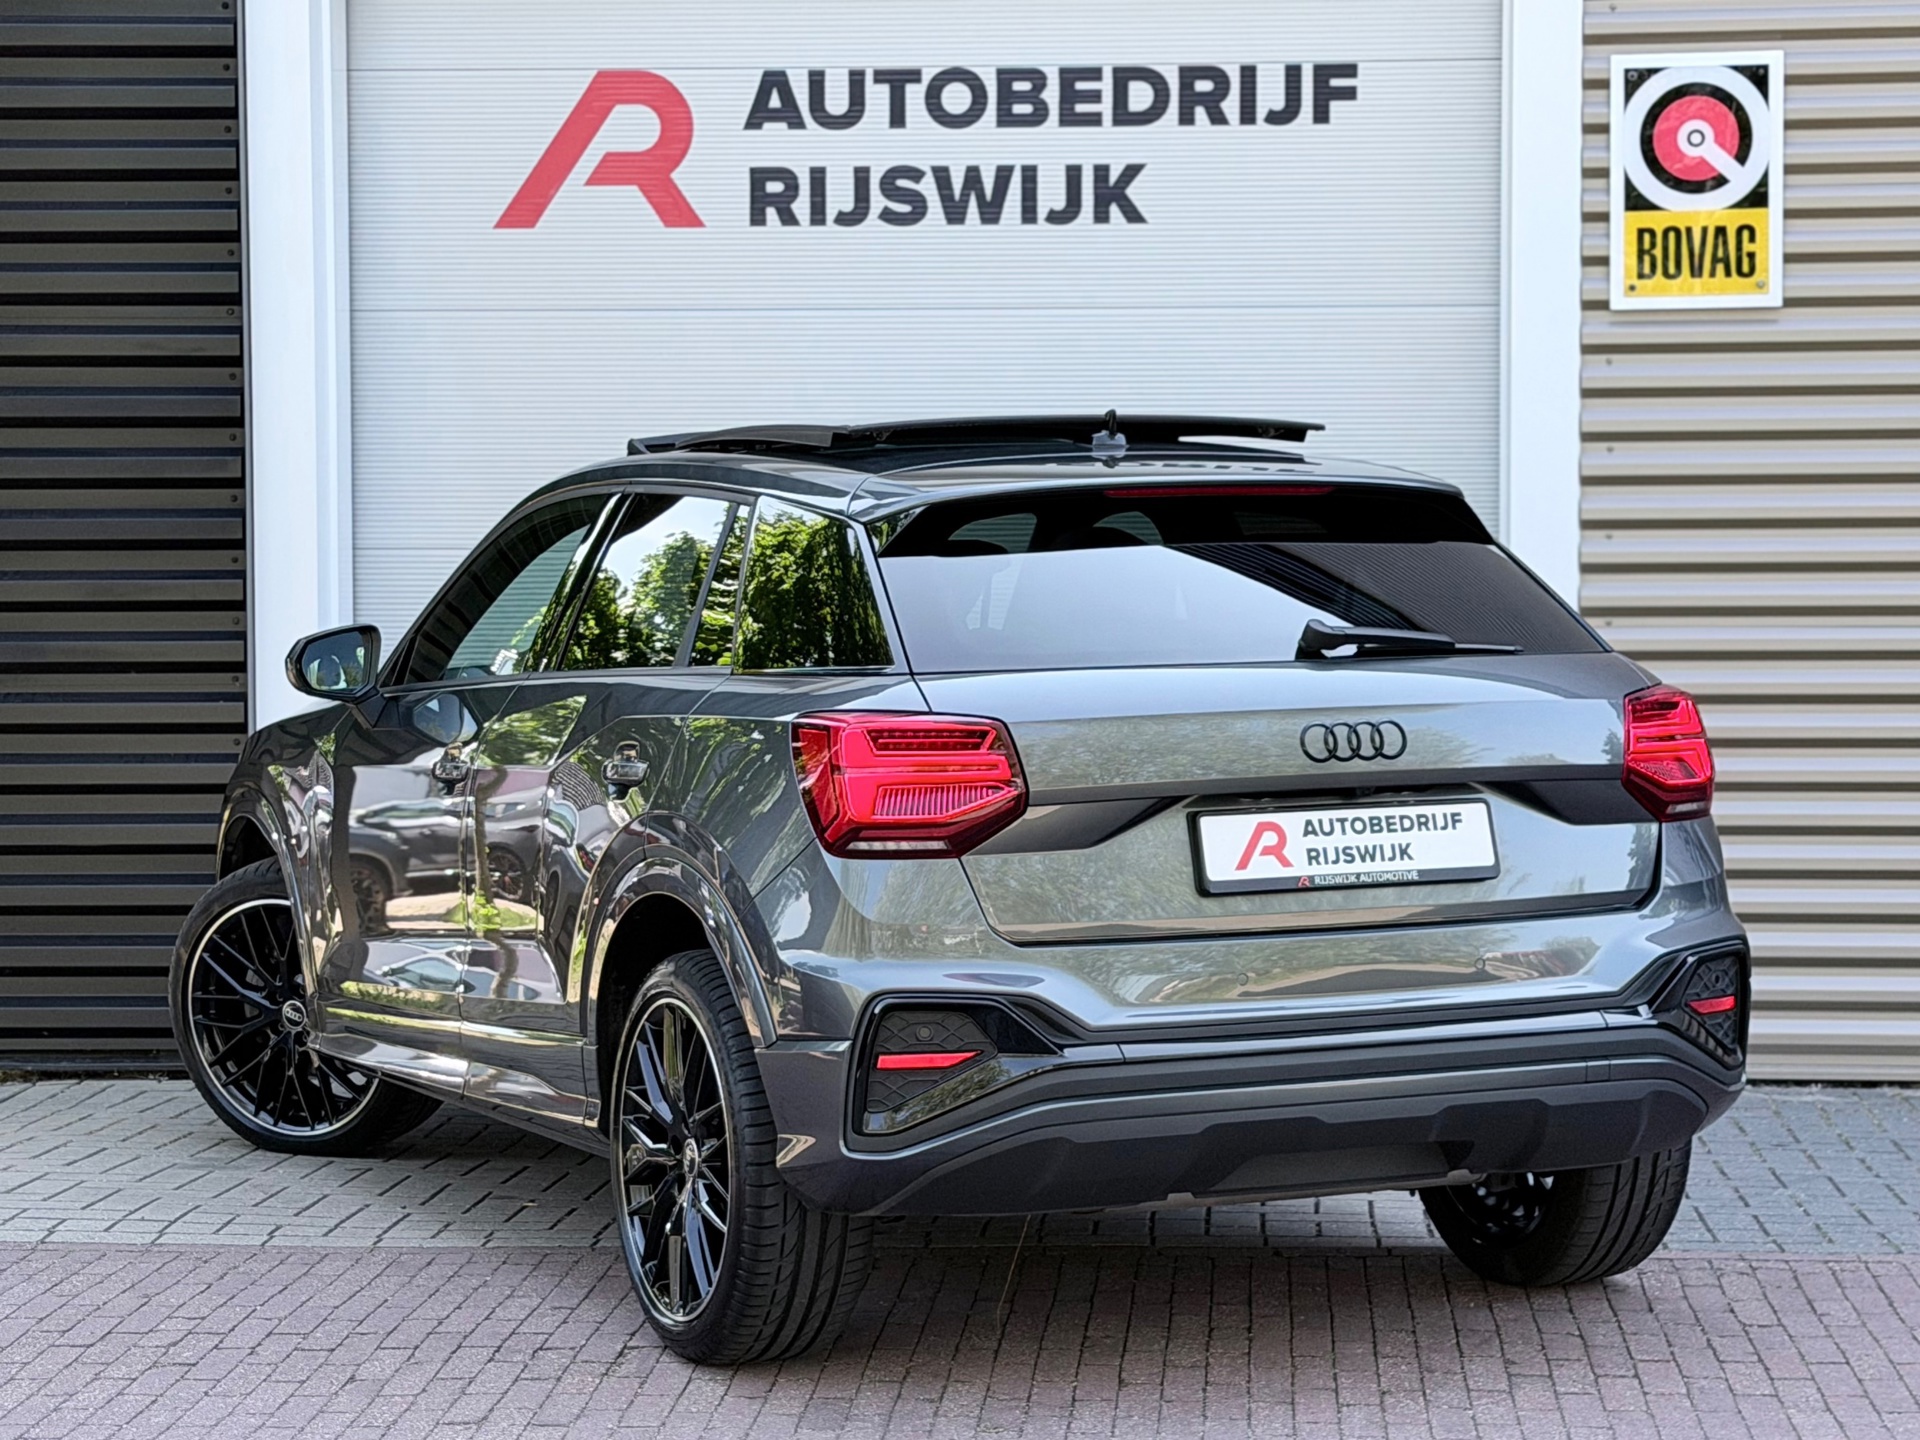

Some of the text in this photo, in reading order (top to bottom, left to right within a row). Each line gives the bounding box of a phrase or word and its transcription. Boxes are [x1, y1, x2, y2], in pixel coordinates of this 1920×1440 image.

[743, 63, 1359, 131] AUTOBEDRIJF
[749, 163, 1147, 228] RIJSWIJK
[1636, 223, 1757, 281] BOVAG
[1301, 811, 1464, 838] AUTOBEDRIJF
[1305, 842, 1415, 867] RIJSWIJK
[1314, 874, 1358, 885] RIJSWIJK
[1359, 870, 1419, 883] AUTOMOTIVE
